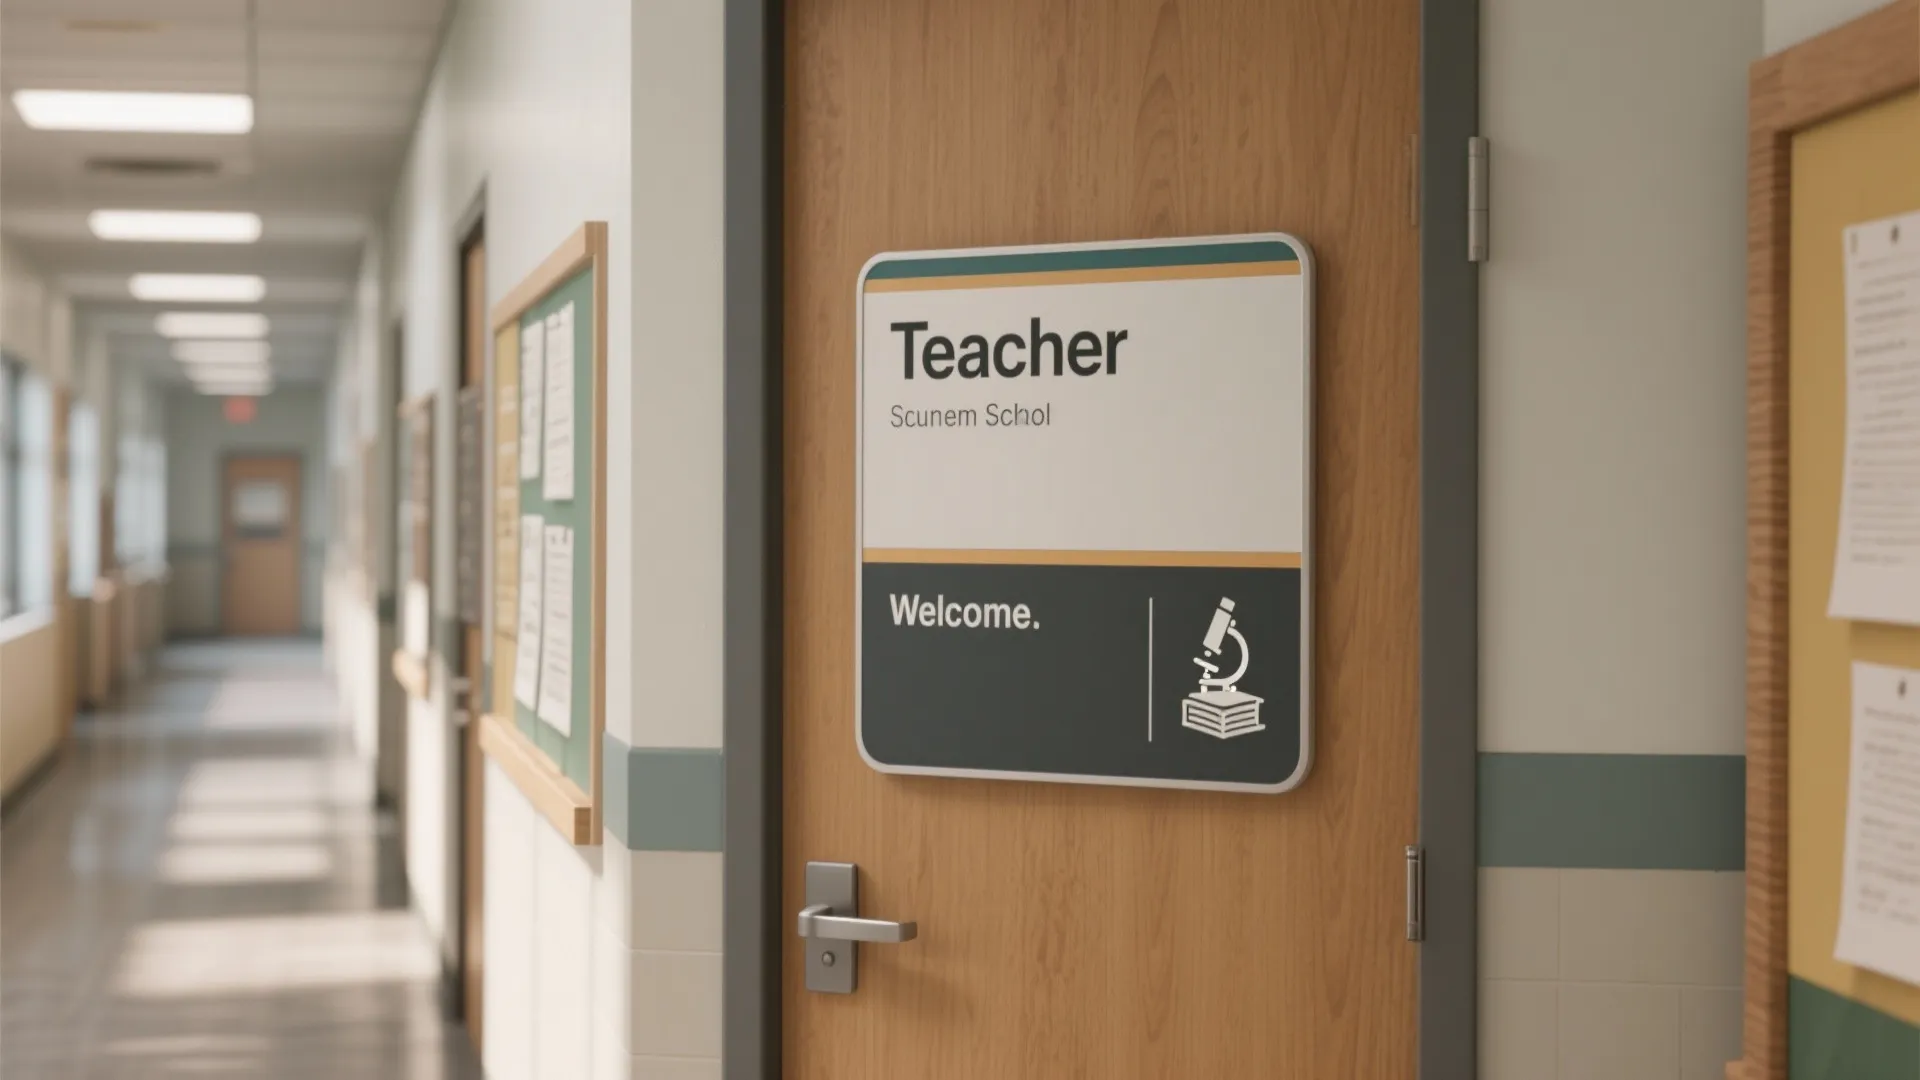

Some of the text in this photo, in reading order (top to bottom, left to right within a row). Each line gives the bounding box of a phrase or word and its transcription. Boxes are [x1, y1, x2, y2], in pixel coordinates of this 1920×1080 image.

[890, 317, 1128, 380] Teacher
[891, 404, 977, 428] Scunem
[890, 594, 1040, 630] Welcome.
